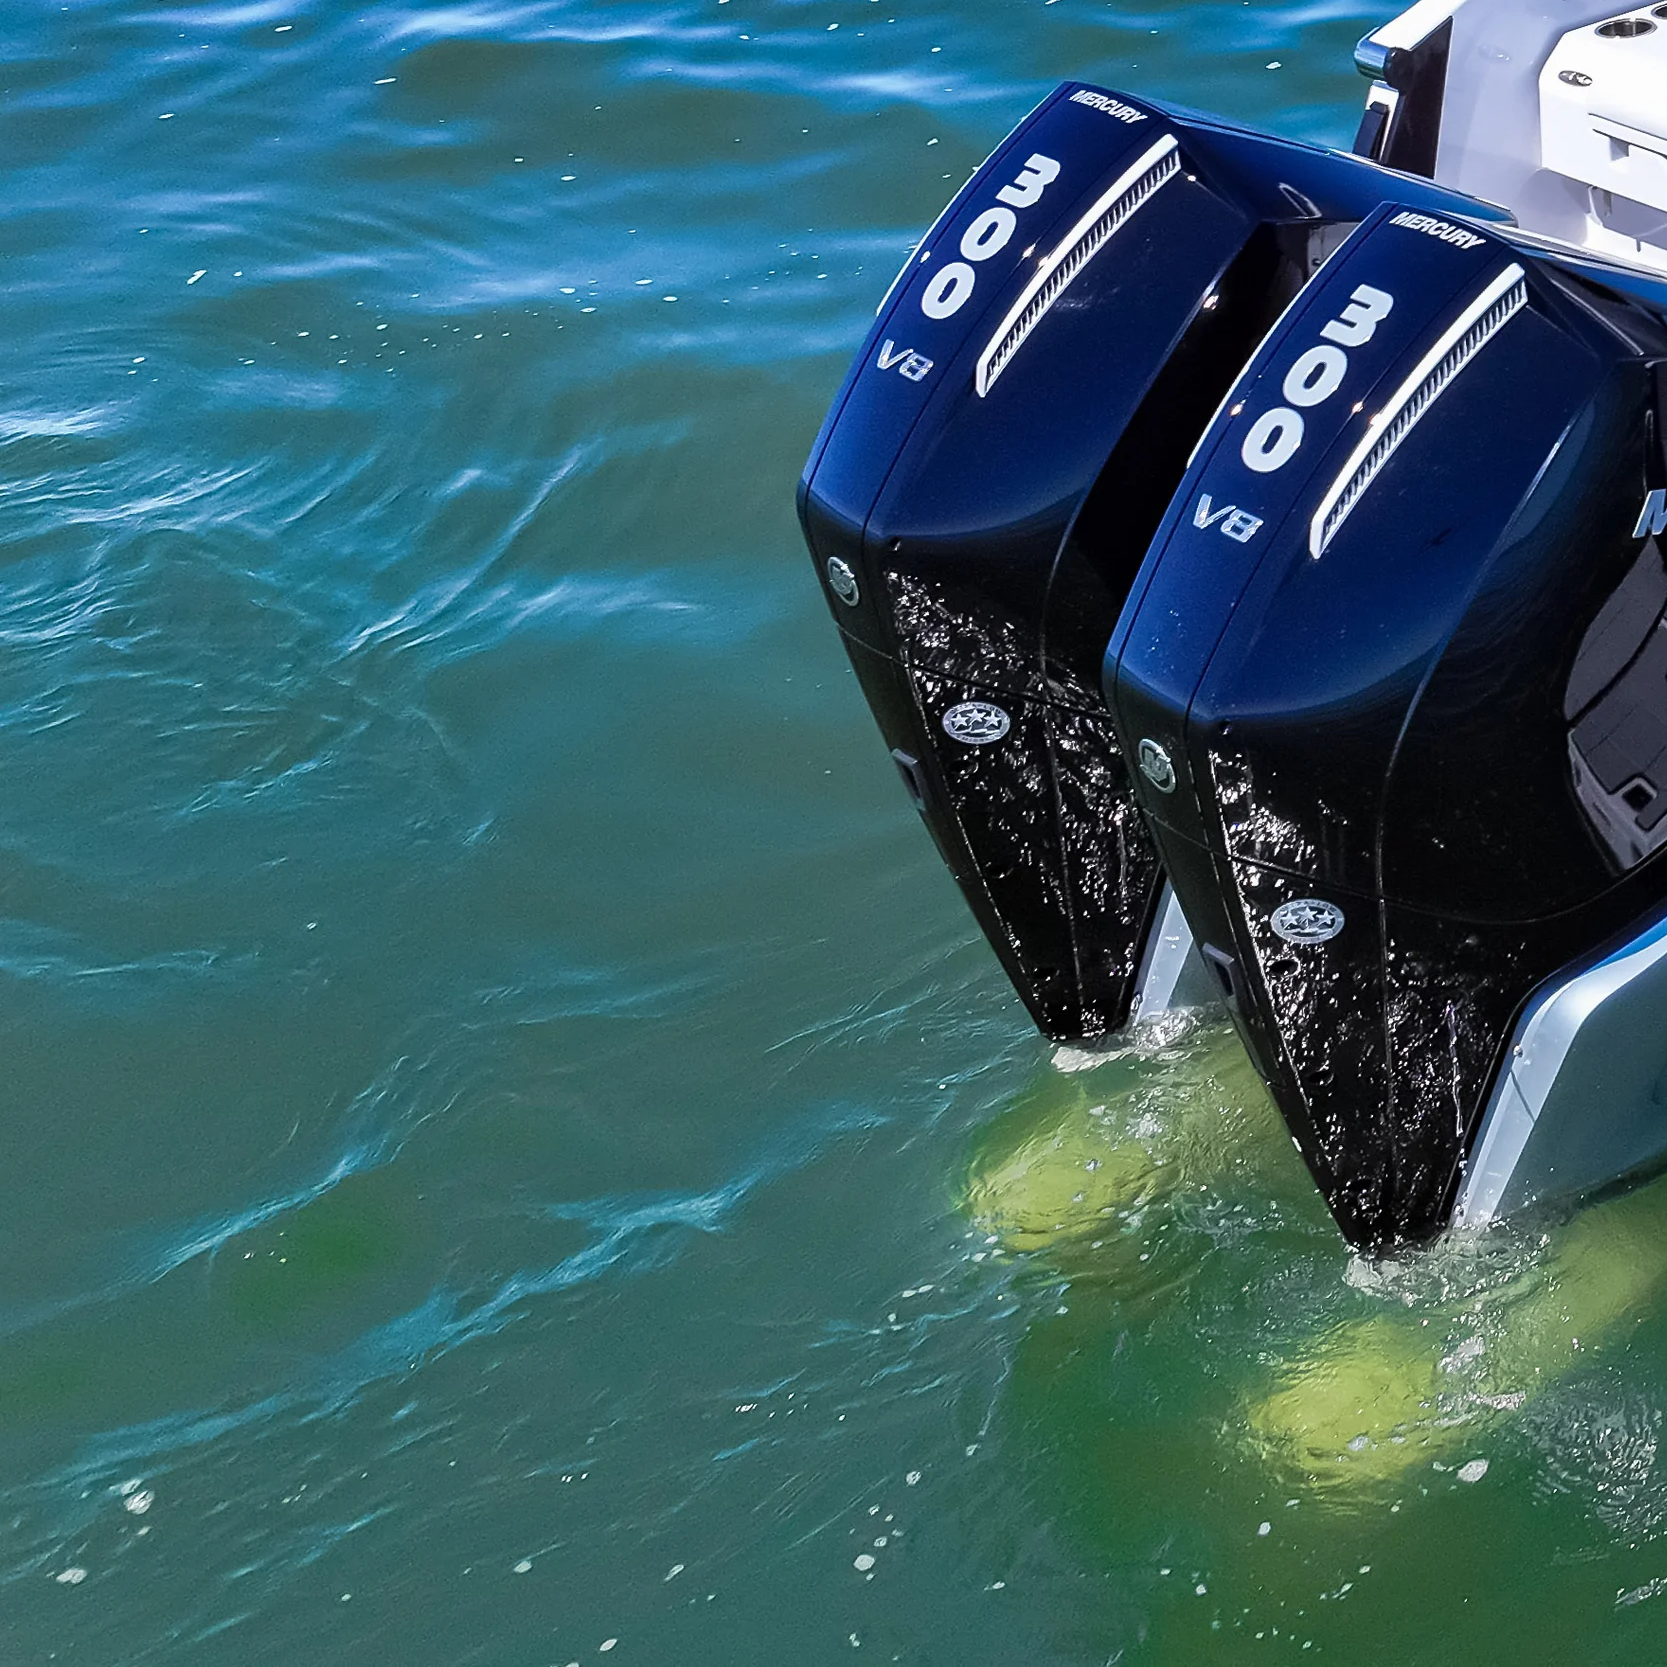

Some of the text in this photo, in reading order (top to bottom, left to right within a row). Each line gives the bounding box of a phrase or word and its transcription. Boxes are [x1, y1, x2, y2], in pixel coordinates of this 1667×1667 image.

[1068, 90, 1148, 124] MERCURY
[921, 153, 1061, 319] 300
[1389, 211, 1487, 250] MERCURY
[877, 339, 934, 382] V8
[1241, 284, 1394, 473] 300
[1193, 494, 1264, 543] V8
